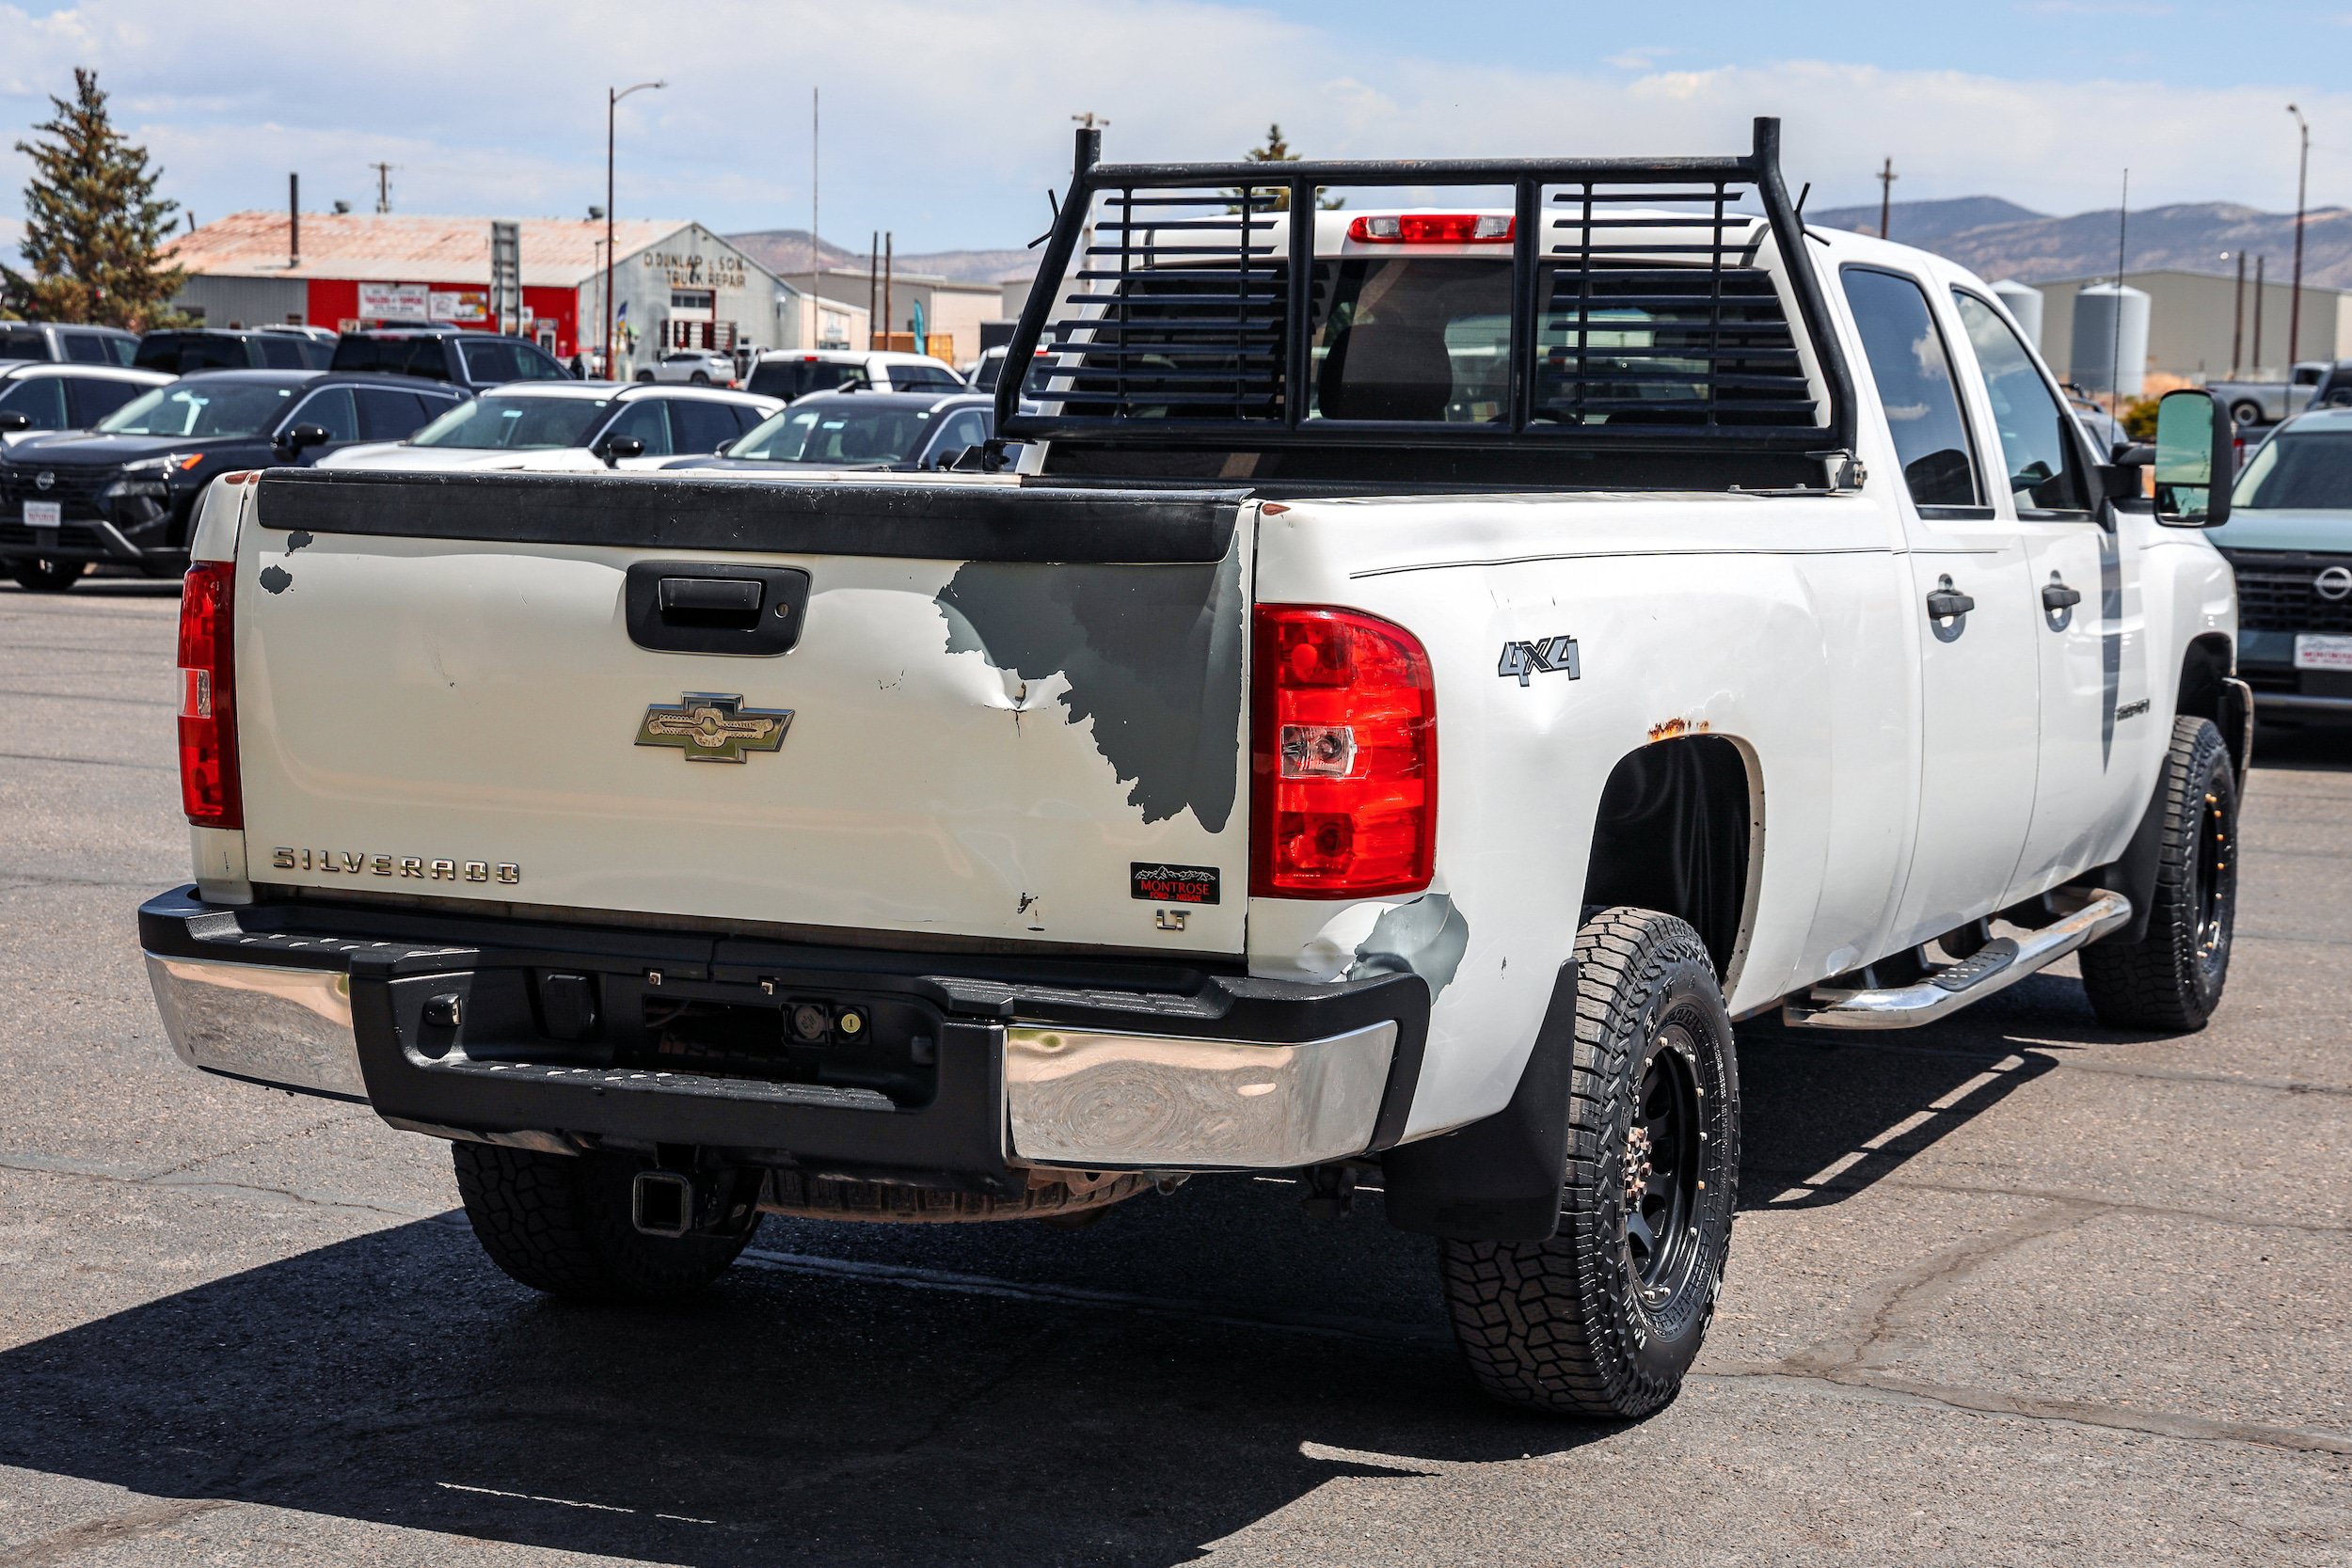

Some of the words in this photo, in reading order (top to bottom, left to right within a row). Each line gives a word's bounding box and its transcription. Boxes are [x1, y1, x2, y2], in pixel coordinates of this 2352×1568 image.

[719, 256, 743, 272] SON
[665, 269, 704, 286] TRUCK
[707, 272, 746, 288] REPAIR
[273, 847, 520, 884] SILVERADO
[1141, 879, 1210, 895] MONTROSE
[1150, 891, 1168, 899] FORD
[1176, 893, 1201, 902] NISSAN
[1155, 909, 1192, 931] LT
